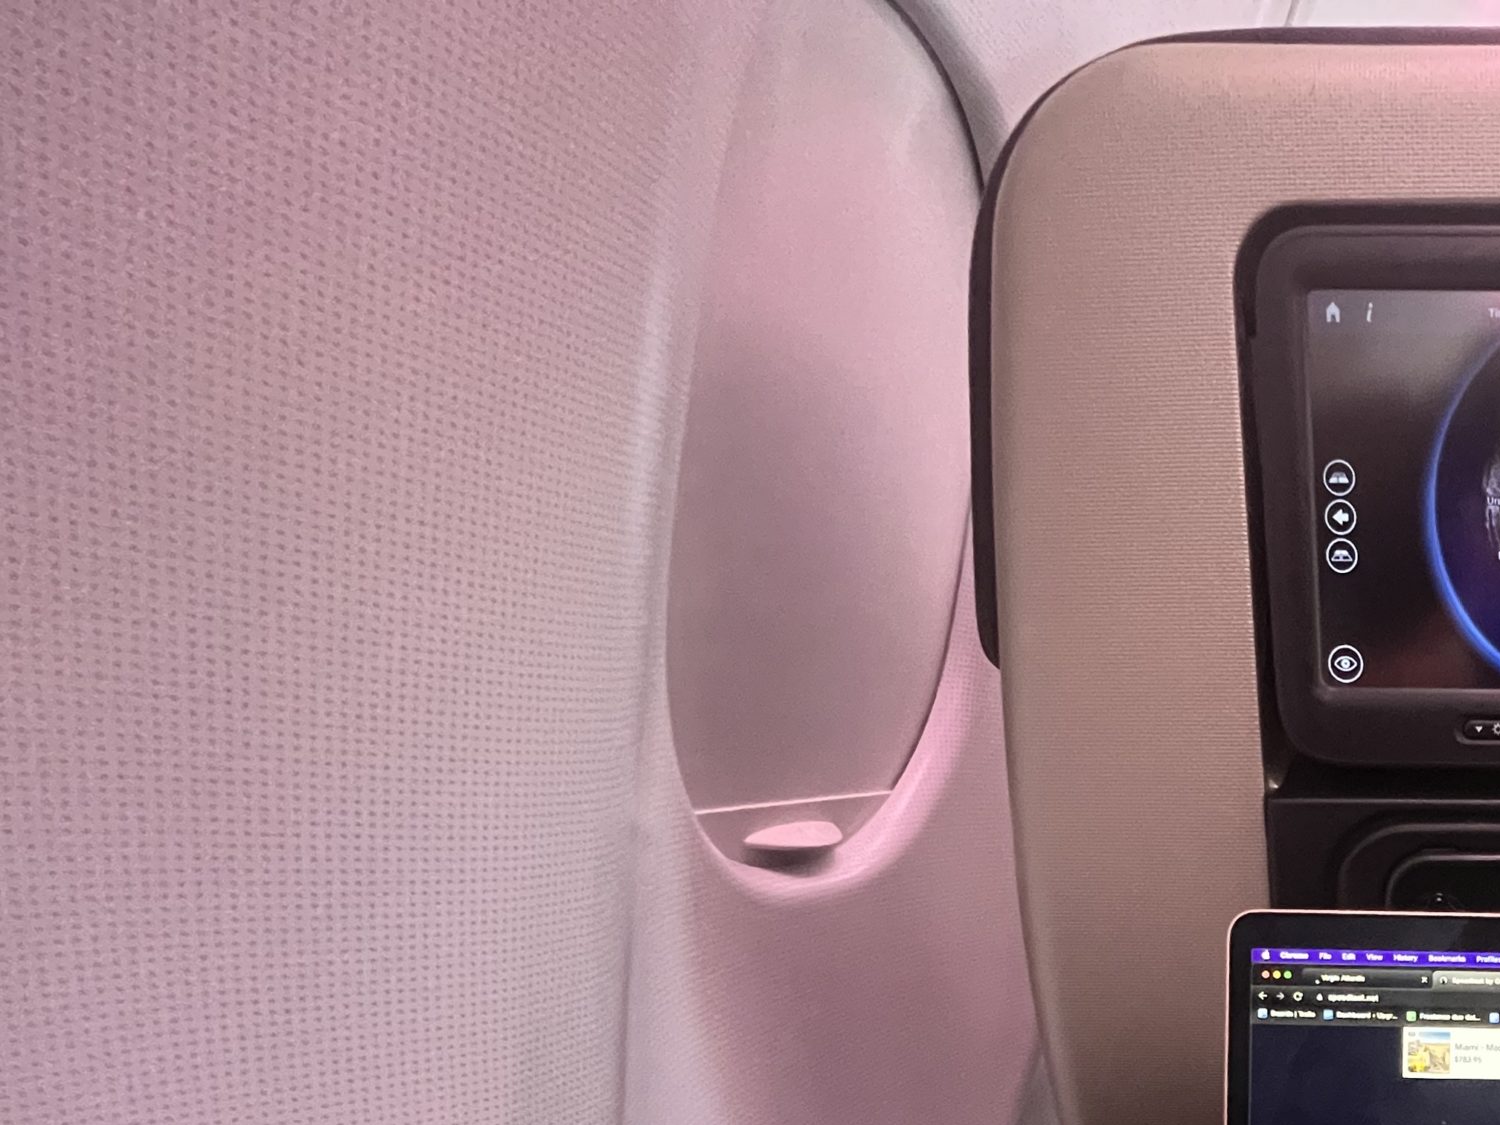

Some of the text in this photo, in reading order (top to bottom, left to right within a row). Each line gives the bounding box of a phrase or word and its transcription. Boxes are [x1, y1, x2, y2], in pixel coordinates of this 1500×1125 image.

[1280, 952, 1309, 960] Chrome
[1319, 952, 1332, 960] File
[1366, 953, 1383, 961] View
[1393, 953, 1418, 962] History
[1428, 954, 1466, 963] Bookmarks
[1454, 1043, 1478, 1051] Miami
